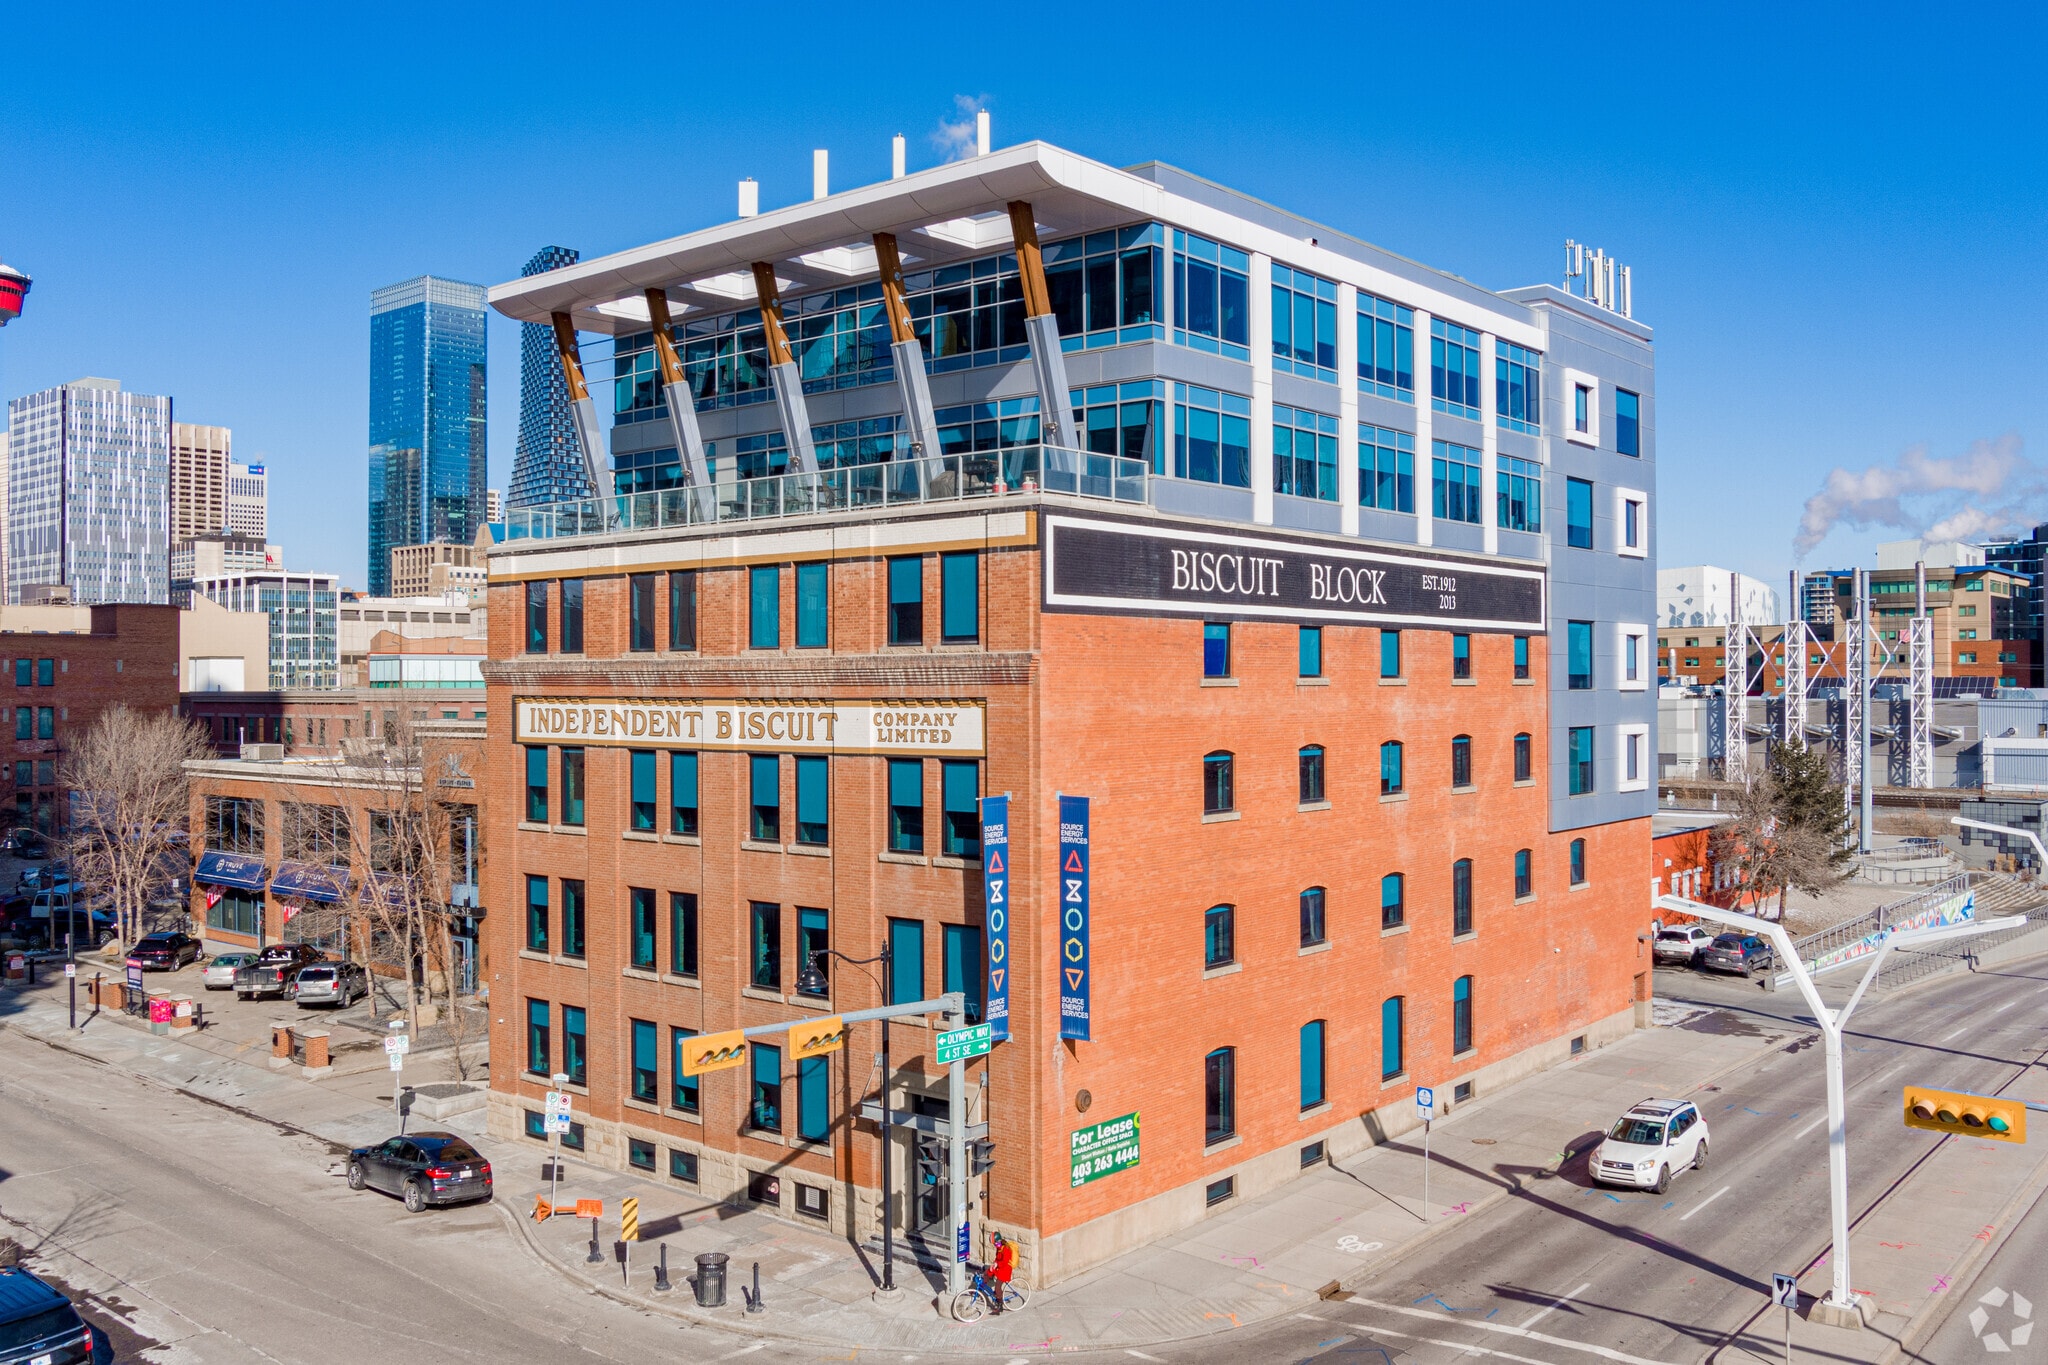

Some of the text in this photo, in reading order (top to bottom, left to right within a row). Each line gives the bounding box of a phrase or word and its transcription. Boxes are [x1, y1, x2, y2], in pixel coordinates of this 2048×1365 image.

[1171, 549, 1387, 605] BISCUIT BLOCK
[1439, 594, 1457, 610] 2013
[529, 707, 838, 742] INDEPENDENT BISCUIT
[873, 712, 958, 727] COMPANY
[877, 728, 952, 744] LIMITED
[984, 824, 1004, 833] SOURCE
[1060, 823, 1084, 831] SOURCE
[984, 831, 1004, 839] ENERGY
[984, 837, 1008, 846] SERVICES
[1060, 836, 1088, 845] SERVICES
[988, 997, 1005, 1007] SOURCE
[1061, 996, 1085, 1005] SOURCE
[987, 1004, 1005, 1014] ENERGY
[1061, 1003, 1085, 1011] ENERGY
[987, 1010, 1009, 1020] SERVICES
[1061, 1010, 1089, 1019] SERVICES
[947, 1025, 989, 1045] OLYMPIC WAY
[944, 1044, 972, 1060] 4 ST SE
[1072, 1119, 1134, 1149] For Lease
[1072, 1161, 1092, 1180] 403
[1094, 1153, 1113, 1173] 263
[1115, 1144, 1139, 1165] 4444
